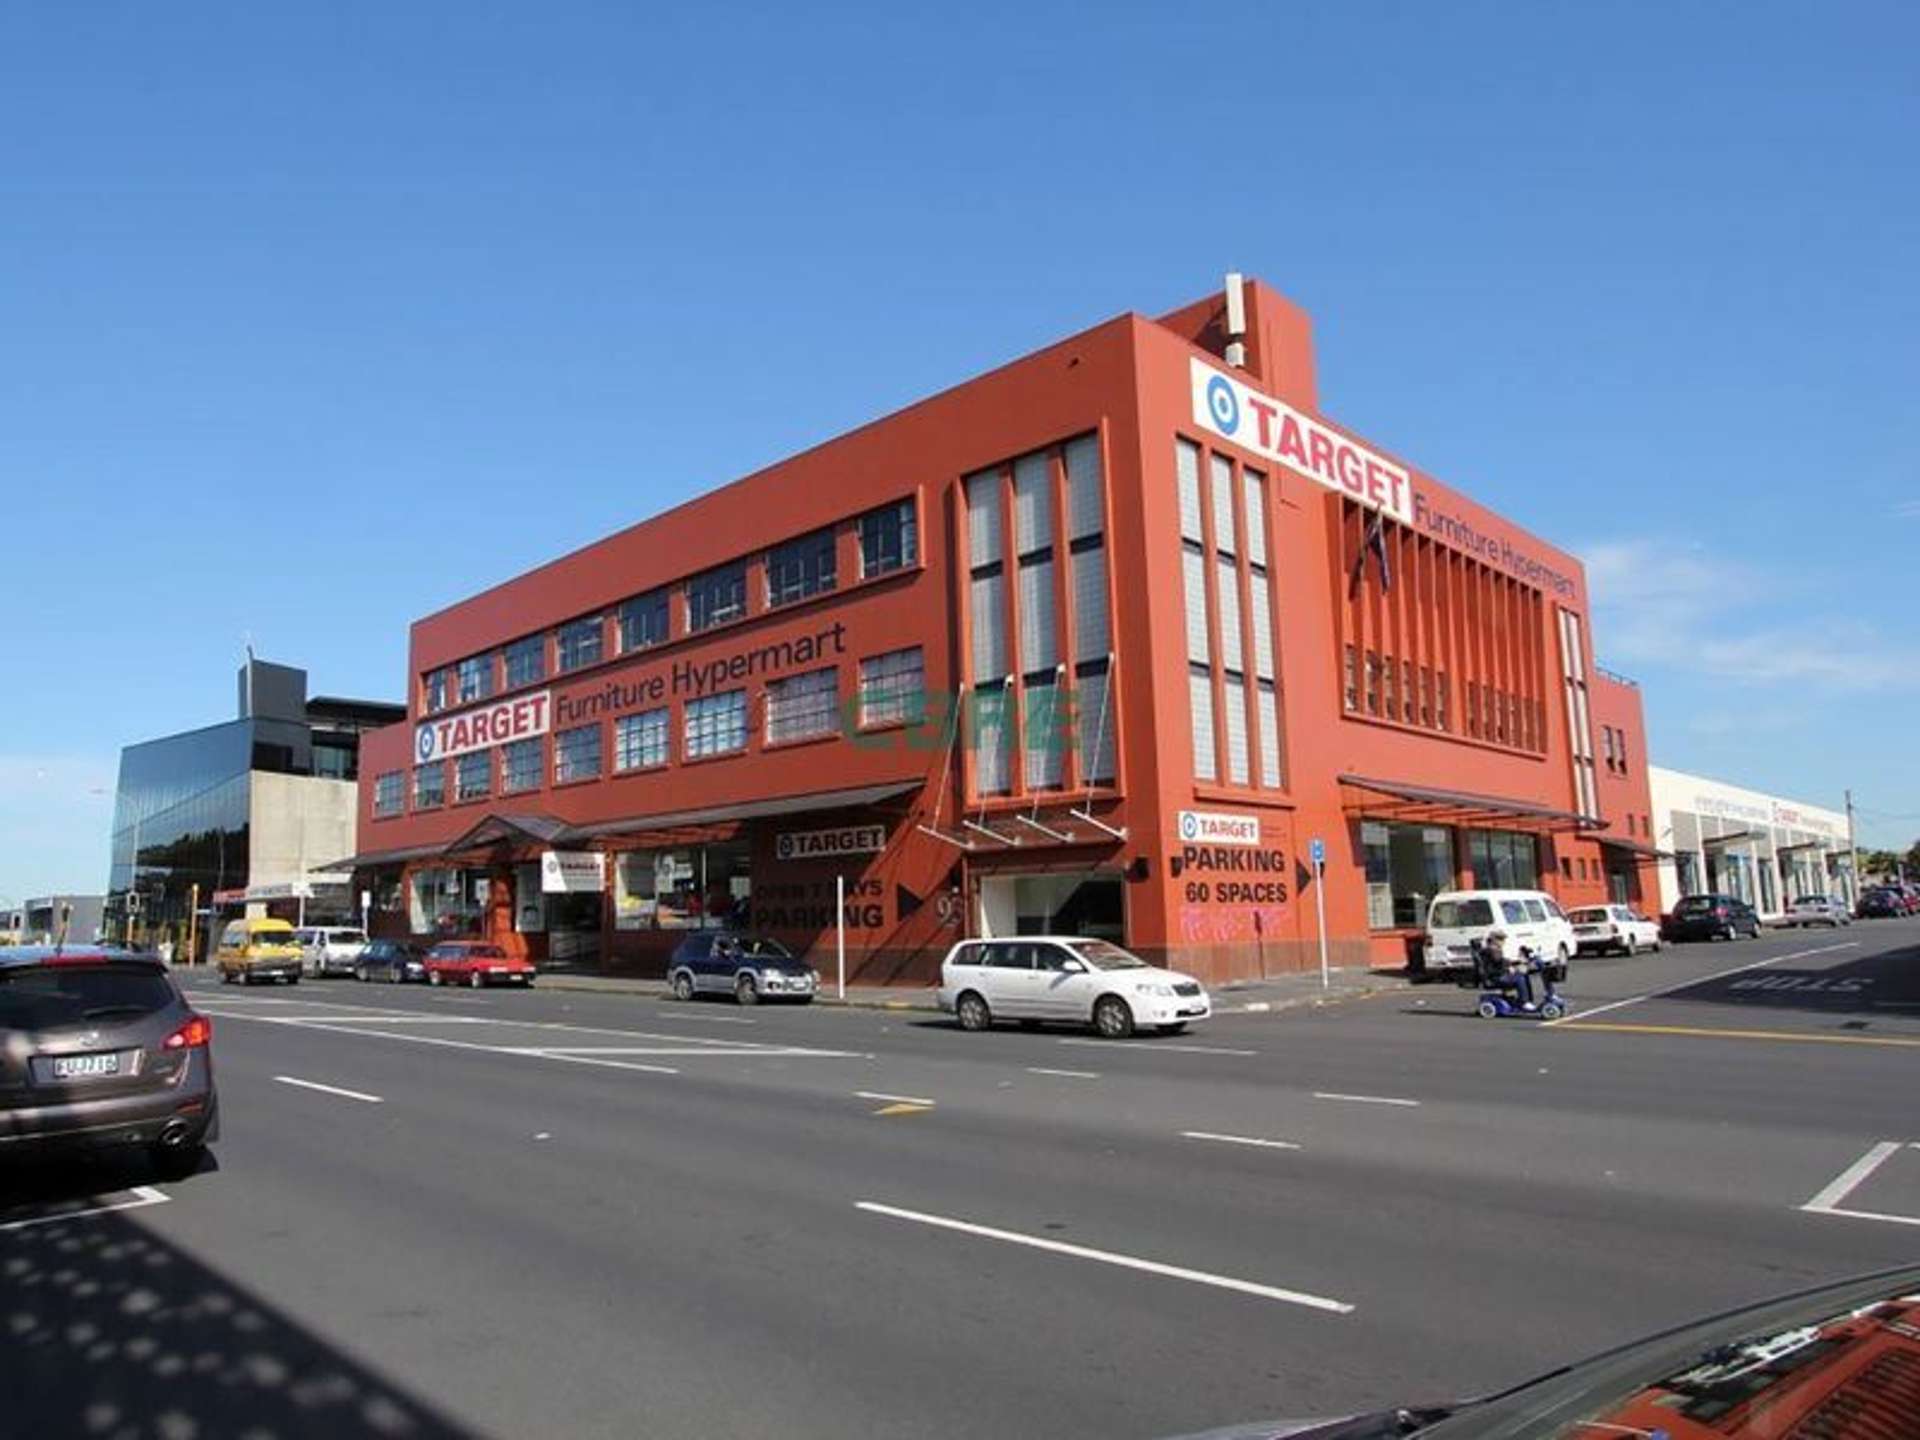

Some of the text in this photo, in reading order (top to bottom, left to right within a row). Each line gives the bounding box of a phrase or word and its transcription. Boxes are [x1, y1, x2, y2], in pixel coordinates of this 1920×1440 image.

[1248, 397, 1403, 512] TARGET
[1415, 491, 1499, 560] Furniture
[438, 621, 846, 752] TARGET Furniture Hypermart
[800, 829, 883, 852] TARGET
[1200, 819, 1256, 840] TARGET
[1183, 847, 1286, 872] PARKING
[1185, 881, 1288, 903] 60 SPACES
[755, 902, 884, 929] PARKING
